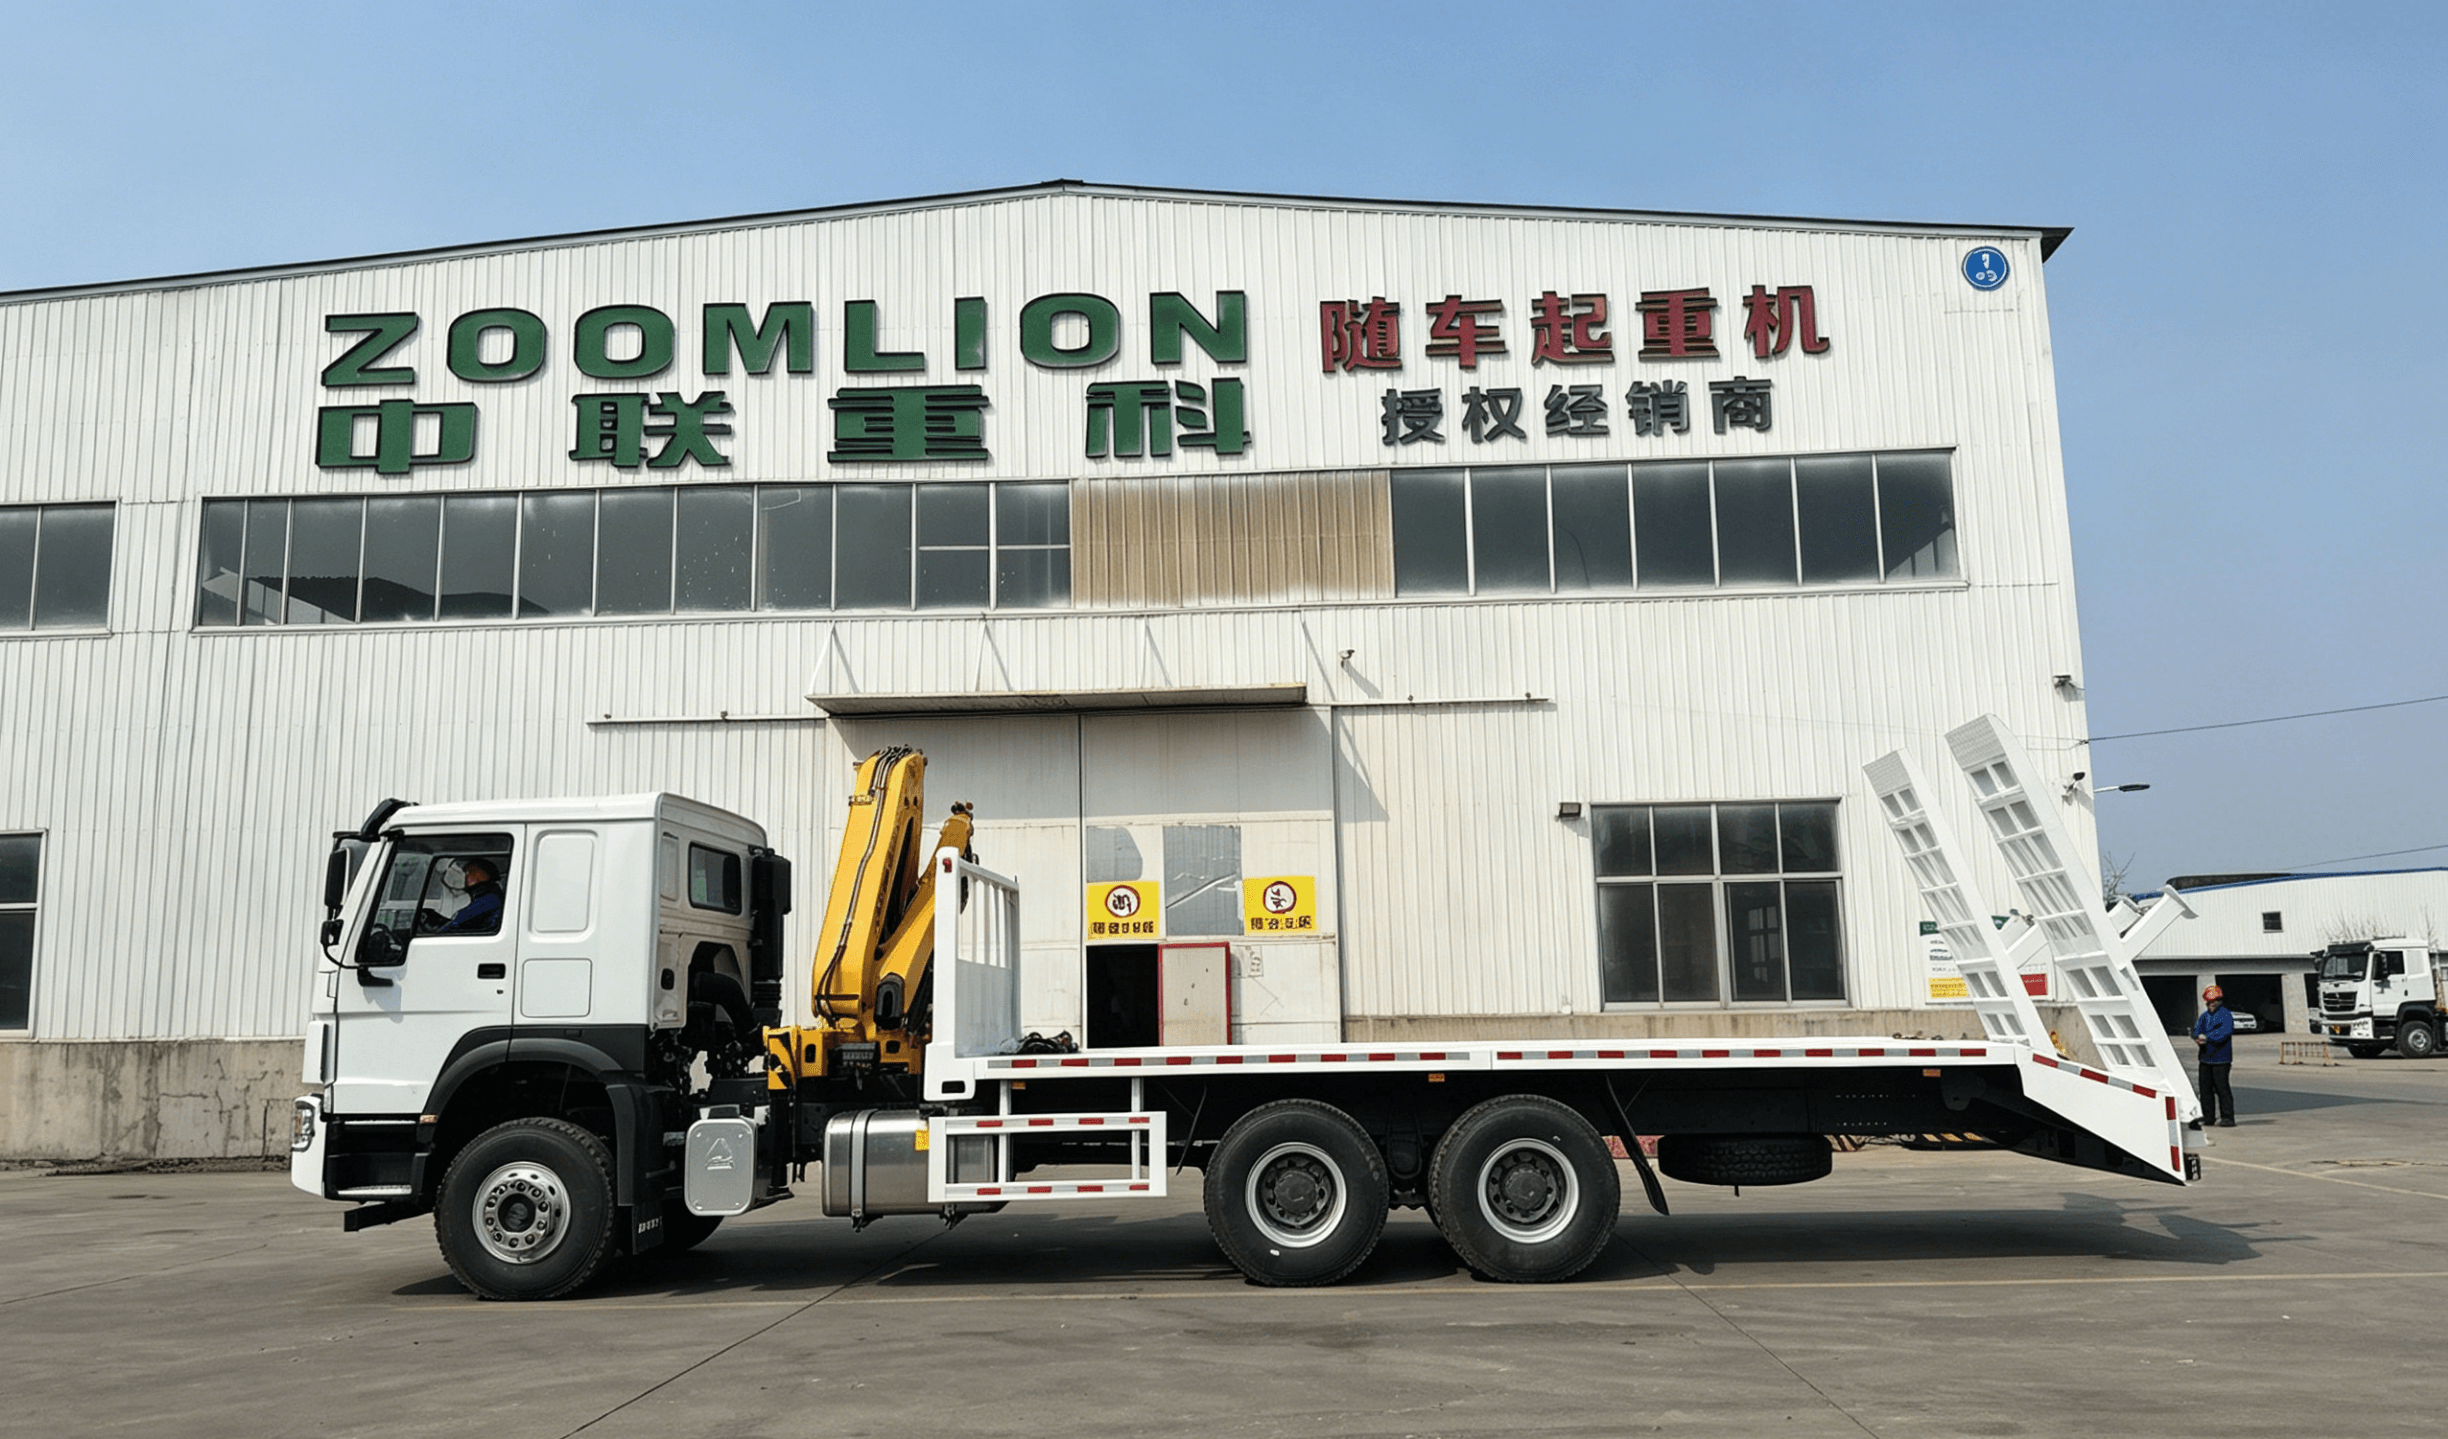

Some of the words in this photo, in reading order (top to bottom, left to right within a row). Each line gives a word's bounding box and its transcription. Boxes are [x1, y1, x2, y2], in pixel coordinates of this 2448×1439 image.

[321, 290, 1247, 386] ZOOMLION
[1320, 285, 1830, 374] 随车起重机
[315, 378, 1251, 475] 中联重科
[1381, 375, 1774, 445] 授权经销商
